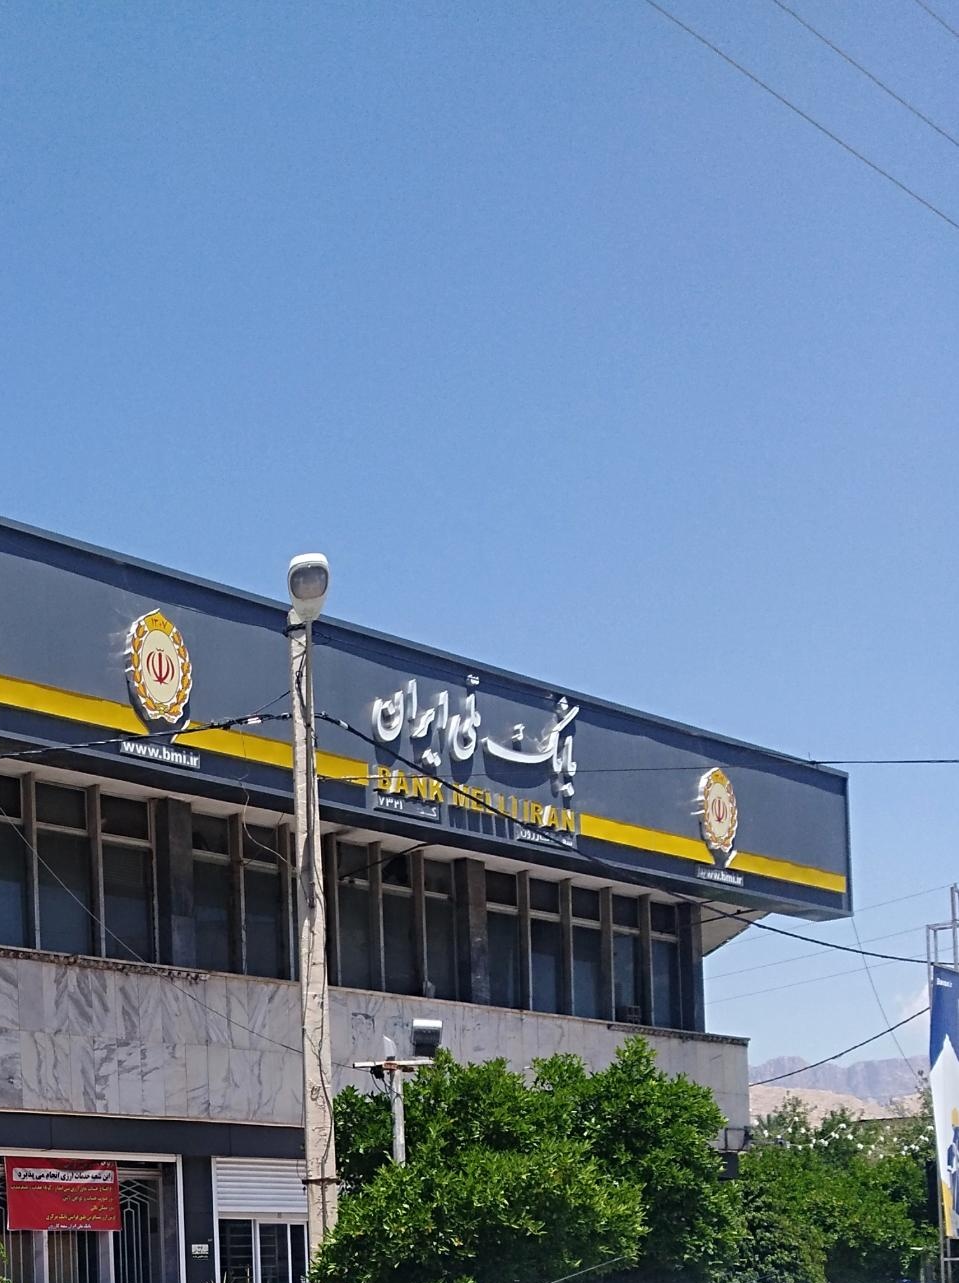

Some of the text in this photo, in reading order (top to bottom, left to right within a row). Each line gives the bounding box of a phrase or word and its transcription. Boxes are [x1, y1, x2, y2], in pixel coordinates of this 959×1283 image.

[371, 674, 580, 798] بانک ملی ایران
[122, 742, 200, 767] www.bmi.ir
[377, 765, 576, 833] BANK MELLI IRAN
[378, 795, 404, 810] ۷۳۲۱
[46, 1171, 60, 1179] انجام
